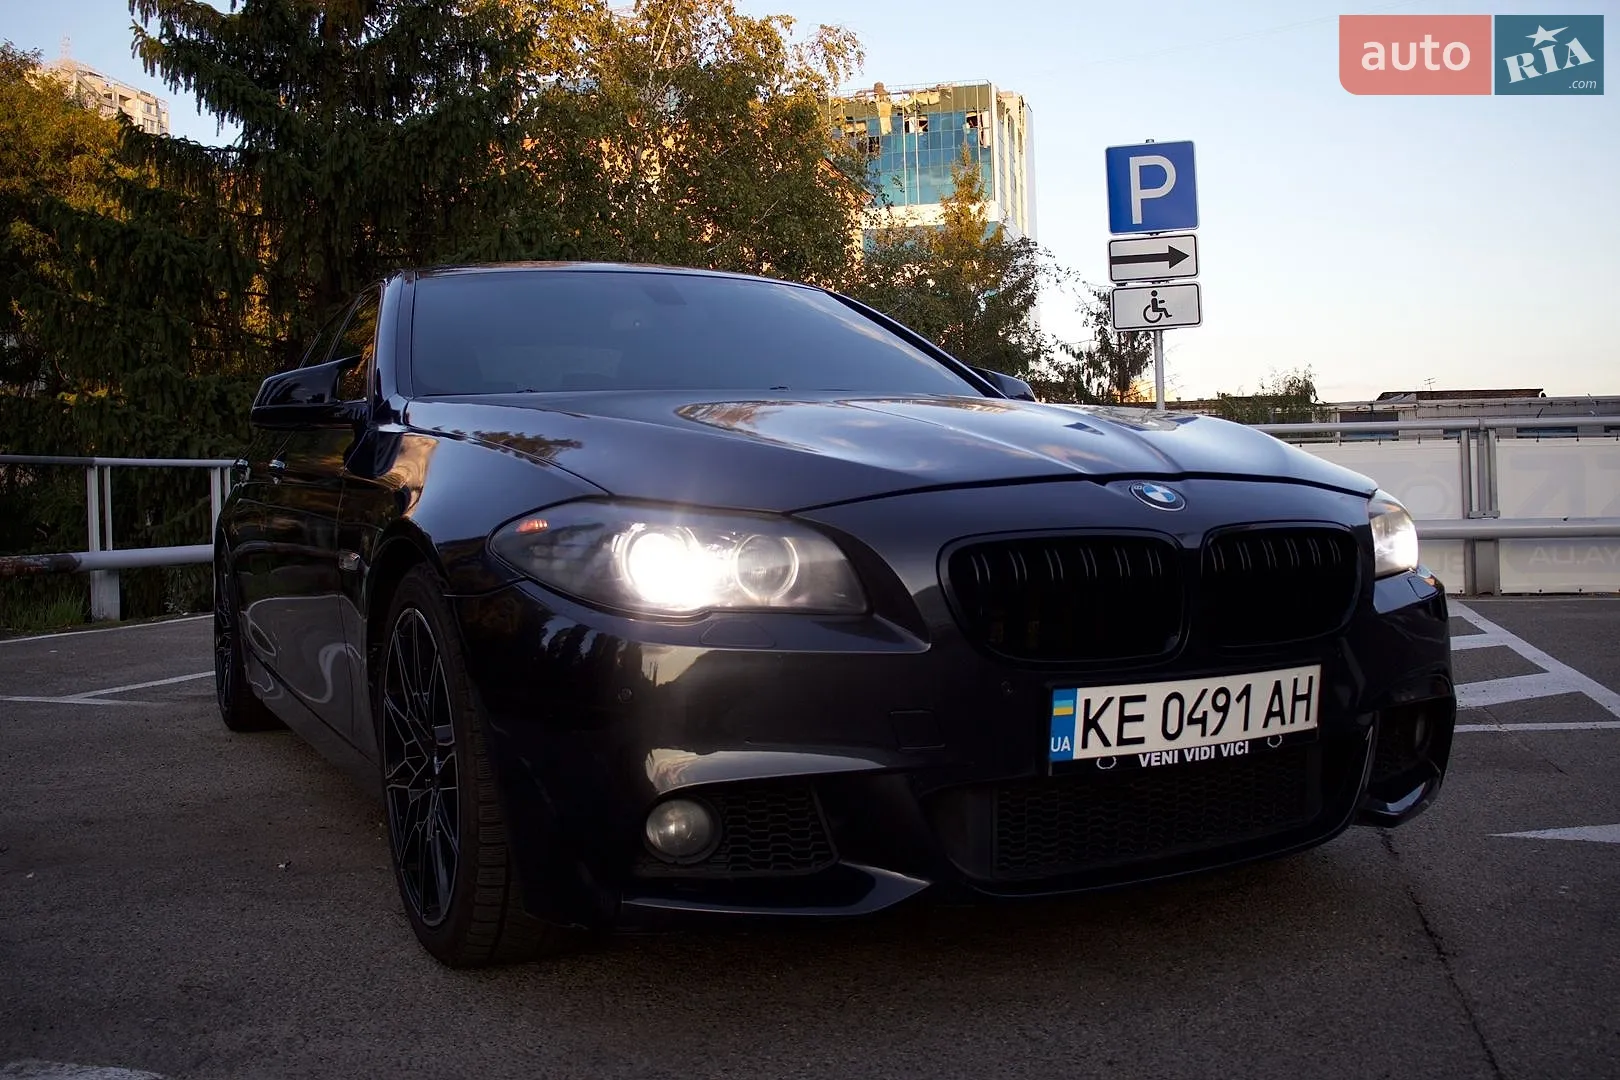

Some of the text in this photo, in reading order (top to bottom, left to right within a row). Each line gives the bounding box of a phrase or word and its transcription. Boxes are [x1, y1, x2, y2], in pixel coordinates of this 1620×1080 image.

[1129, 155, 1176, 225] P
[1081, 674, 1314, 750] KE 0491 AH
[1050, 735, 1071, 752] UA
[1138, 740, 1249, 768] VENI VIDI VICI
